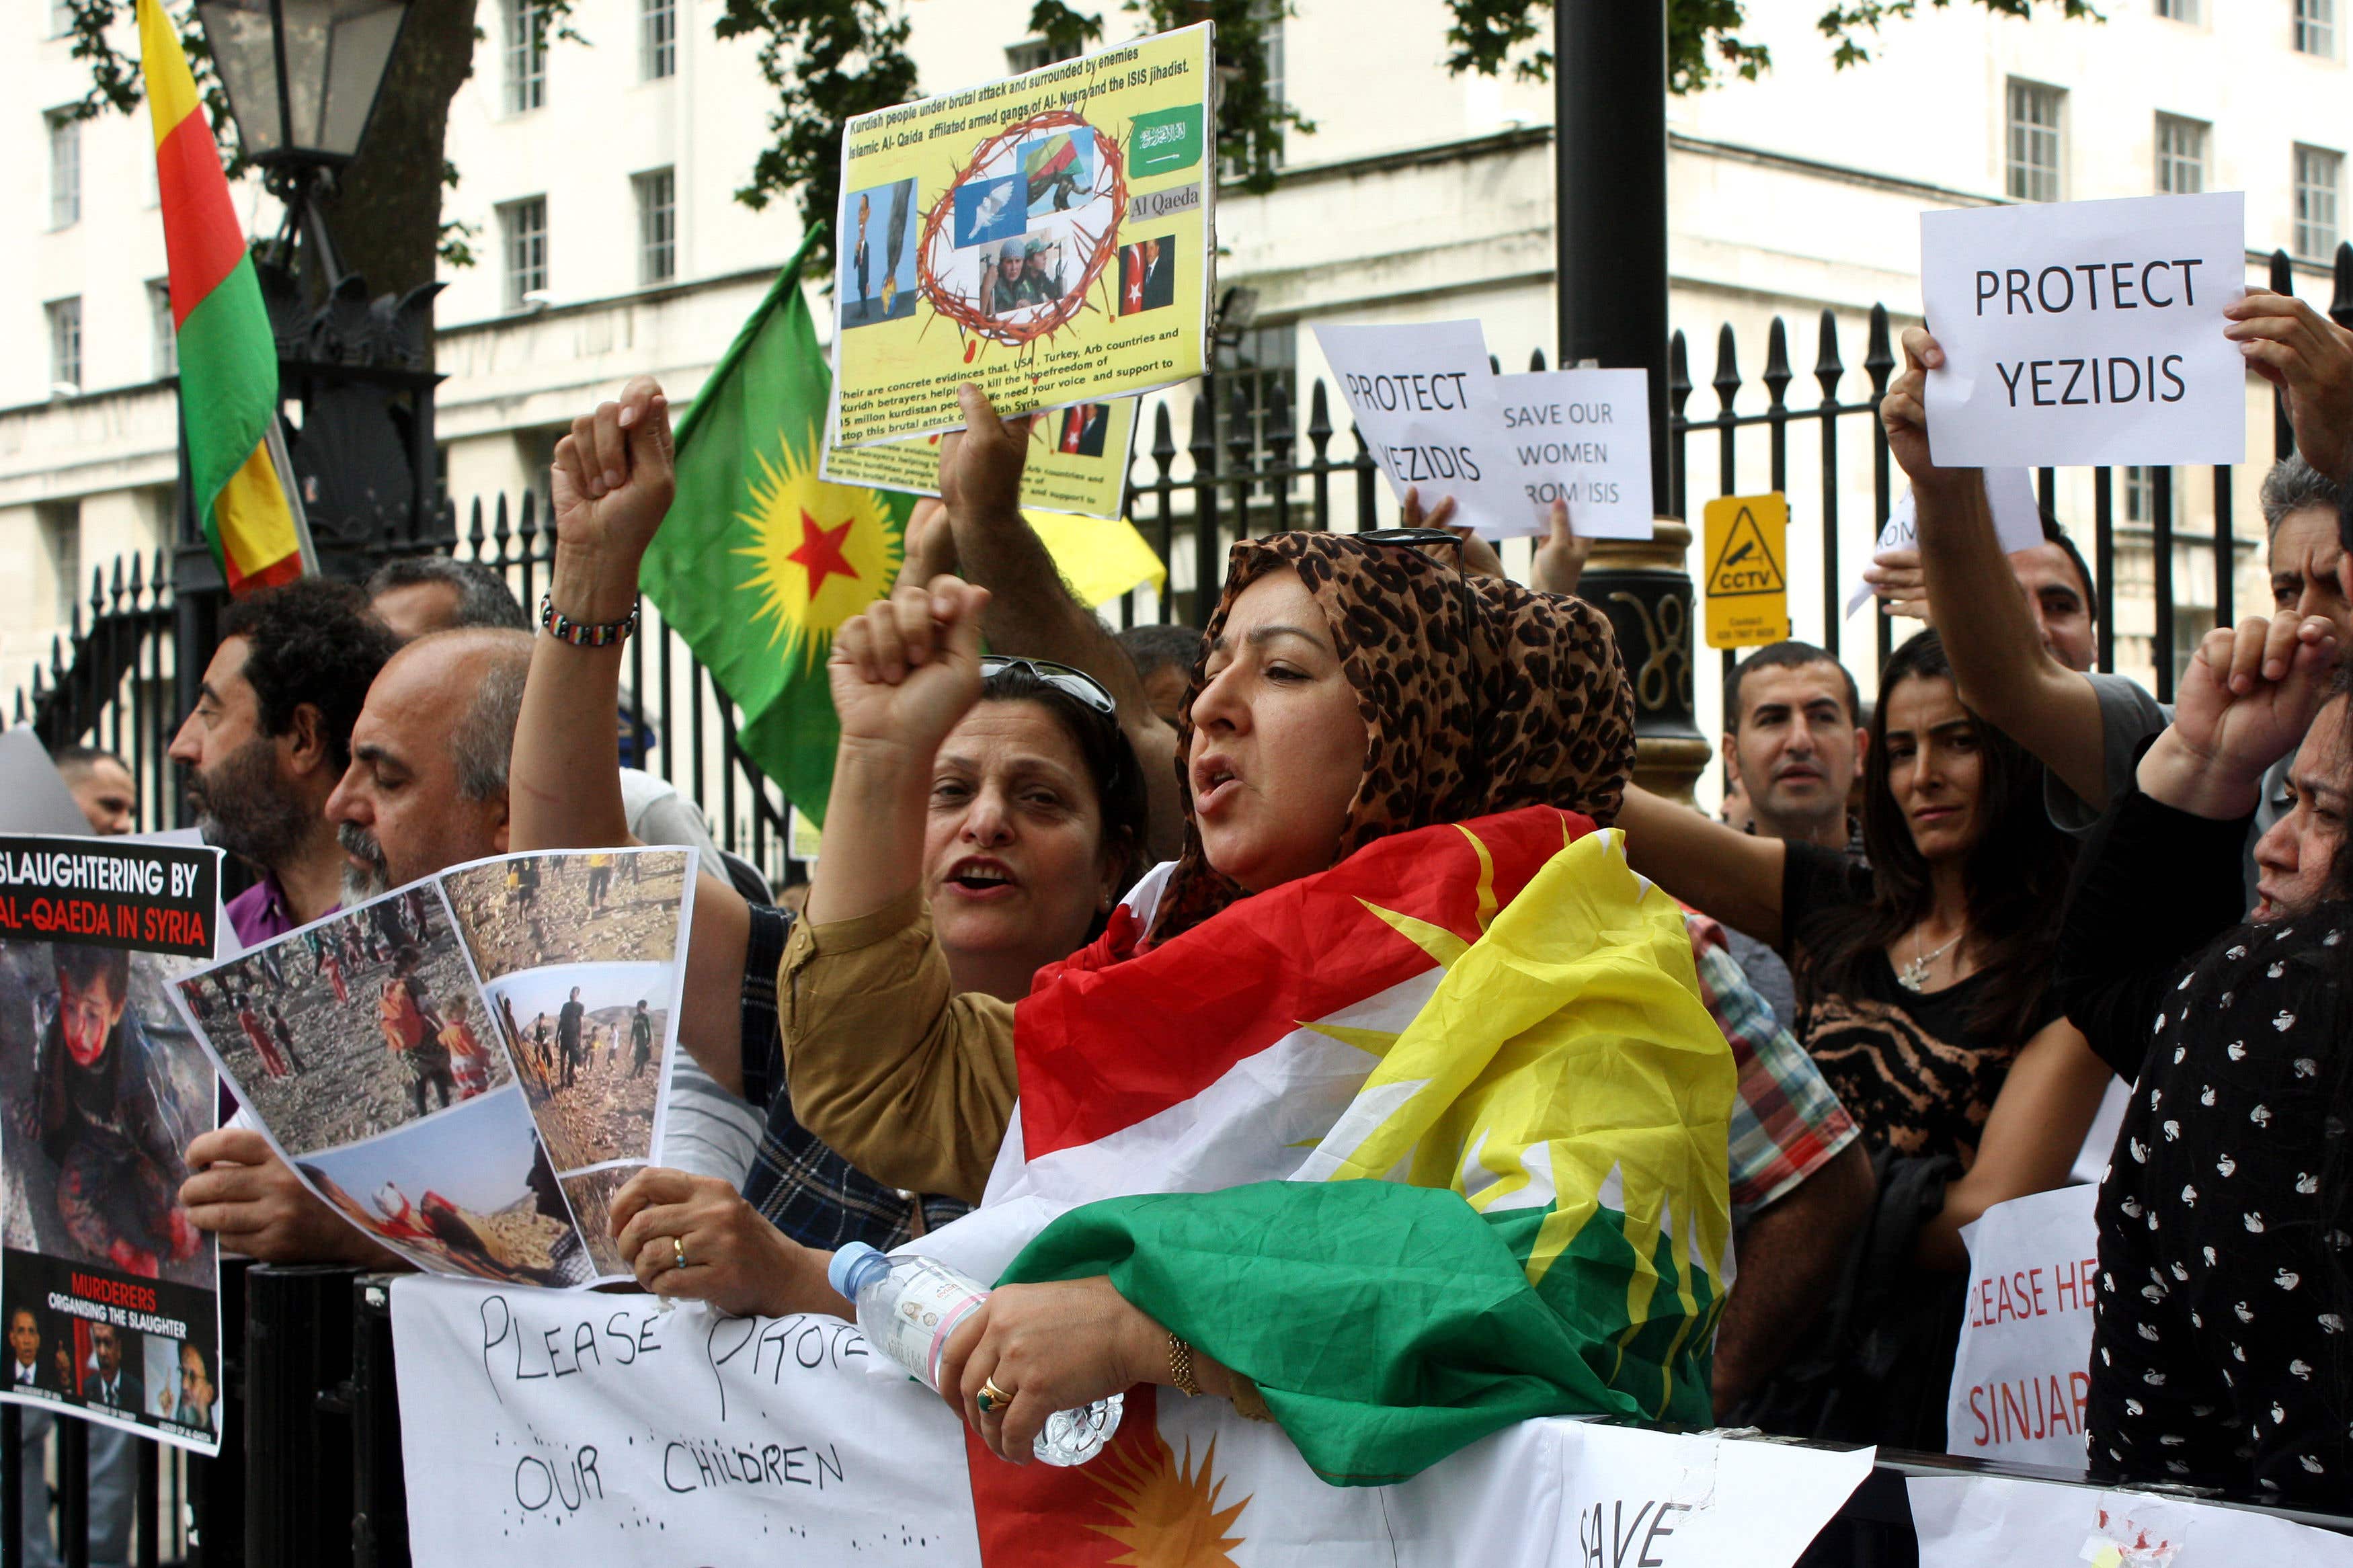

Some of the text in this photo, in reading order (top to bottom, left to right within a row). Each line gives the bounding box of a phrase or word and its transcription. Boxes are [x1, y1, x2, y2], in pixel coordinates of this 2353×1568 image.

[849, 140, 879, 160] Islamic
[898, 128, 923, 147] Qaida
[968, 109, 997, 129] armed
[1032, 99, 1042, 114] of
[1060, 87, 1087, 107] Nusra
[1089, 79, 1107, 98] and
[1109, 75, 1124, 92] the
[1127, 69, 1147, 87] ISIS
[850, 47, 1139, 135] Kurdish people under brutal attack and surrounded by enemies
[1131, 187, 1199, 218] Al Qaeda
[1977, 258, 2203, 317] PROTECT
[867, 387, 884, 397] are
[887, 378, 932, 393] concrete
[935, 369, 985, 384] evidinces
[1084, 344, 1103, 356] Arb
[1106, 334, 1156, 352] countries
[1158, 328, 1179, 341] and
[877, 393, 926, 408] betrayers
[988, 379, 1002, 388] kill
[1005, 374, 1021, 385] the
[1096, 356, 1109, 367] of
[1995, 354, 2186, 407] YEZIDIS
[889, 405, 937, 419] kurdistan
[1004, 386, 1029, 399] need
[1032, 382, 1055, 395] your
[1059, 376, 1086, 388] voice
[1092, 370, 1113, 382] and
[1116, 362, 1159, 379] support
[1162, 359, 1173, 368] to
[1345, 372, 1467, 411] PROTECT
[841, 430, 863, 441] stop
[867, 425, 885, 436] this
[888, 419, 919, 432] brutal
[922, 413, 954, 427] attack
[1014, 398, 1040, 412] Syria
[1504, 402, 1613, 429] SAVE OUR
[1517, 442, 1609, 467] WOMEN
[1589, 481, 1620, 503] ISIS
[1720, 571, 1770, 589] CCTV
[171, 862, 198, 899] BY
[116, 904, 138, 939] IN
[144, 907, 206, 947] SYRIA
[47, 1290, 188, 1340] ORGANISING THE SLAUGHTER
[71, 1272, 157, 1313] MURDERERS
[479, 1294, 662, 1405] PLEASE
[515, 1440, 844, 1511] OUR CHILDREN
[1580, 1499, 1693, 1568] SAVE
